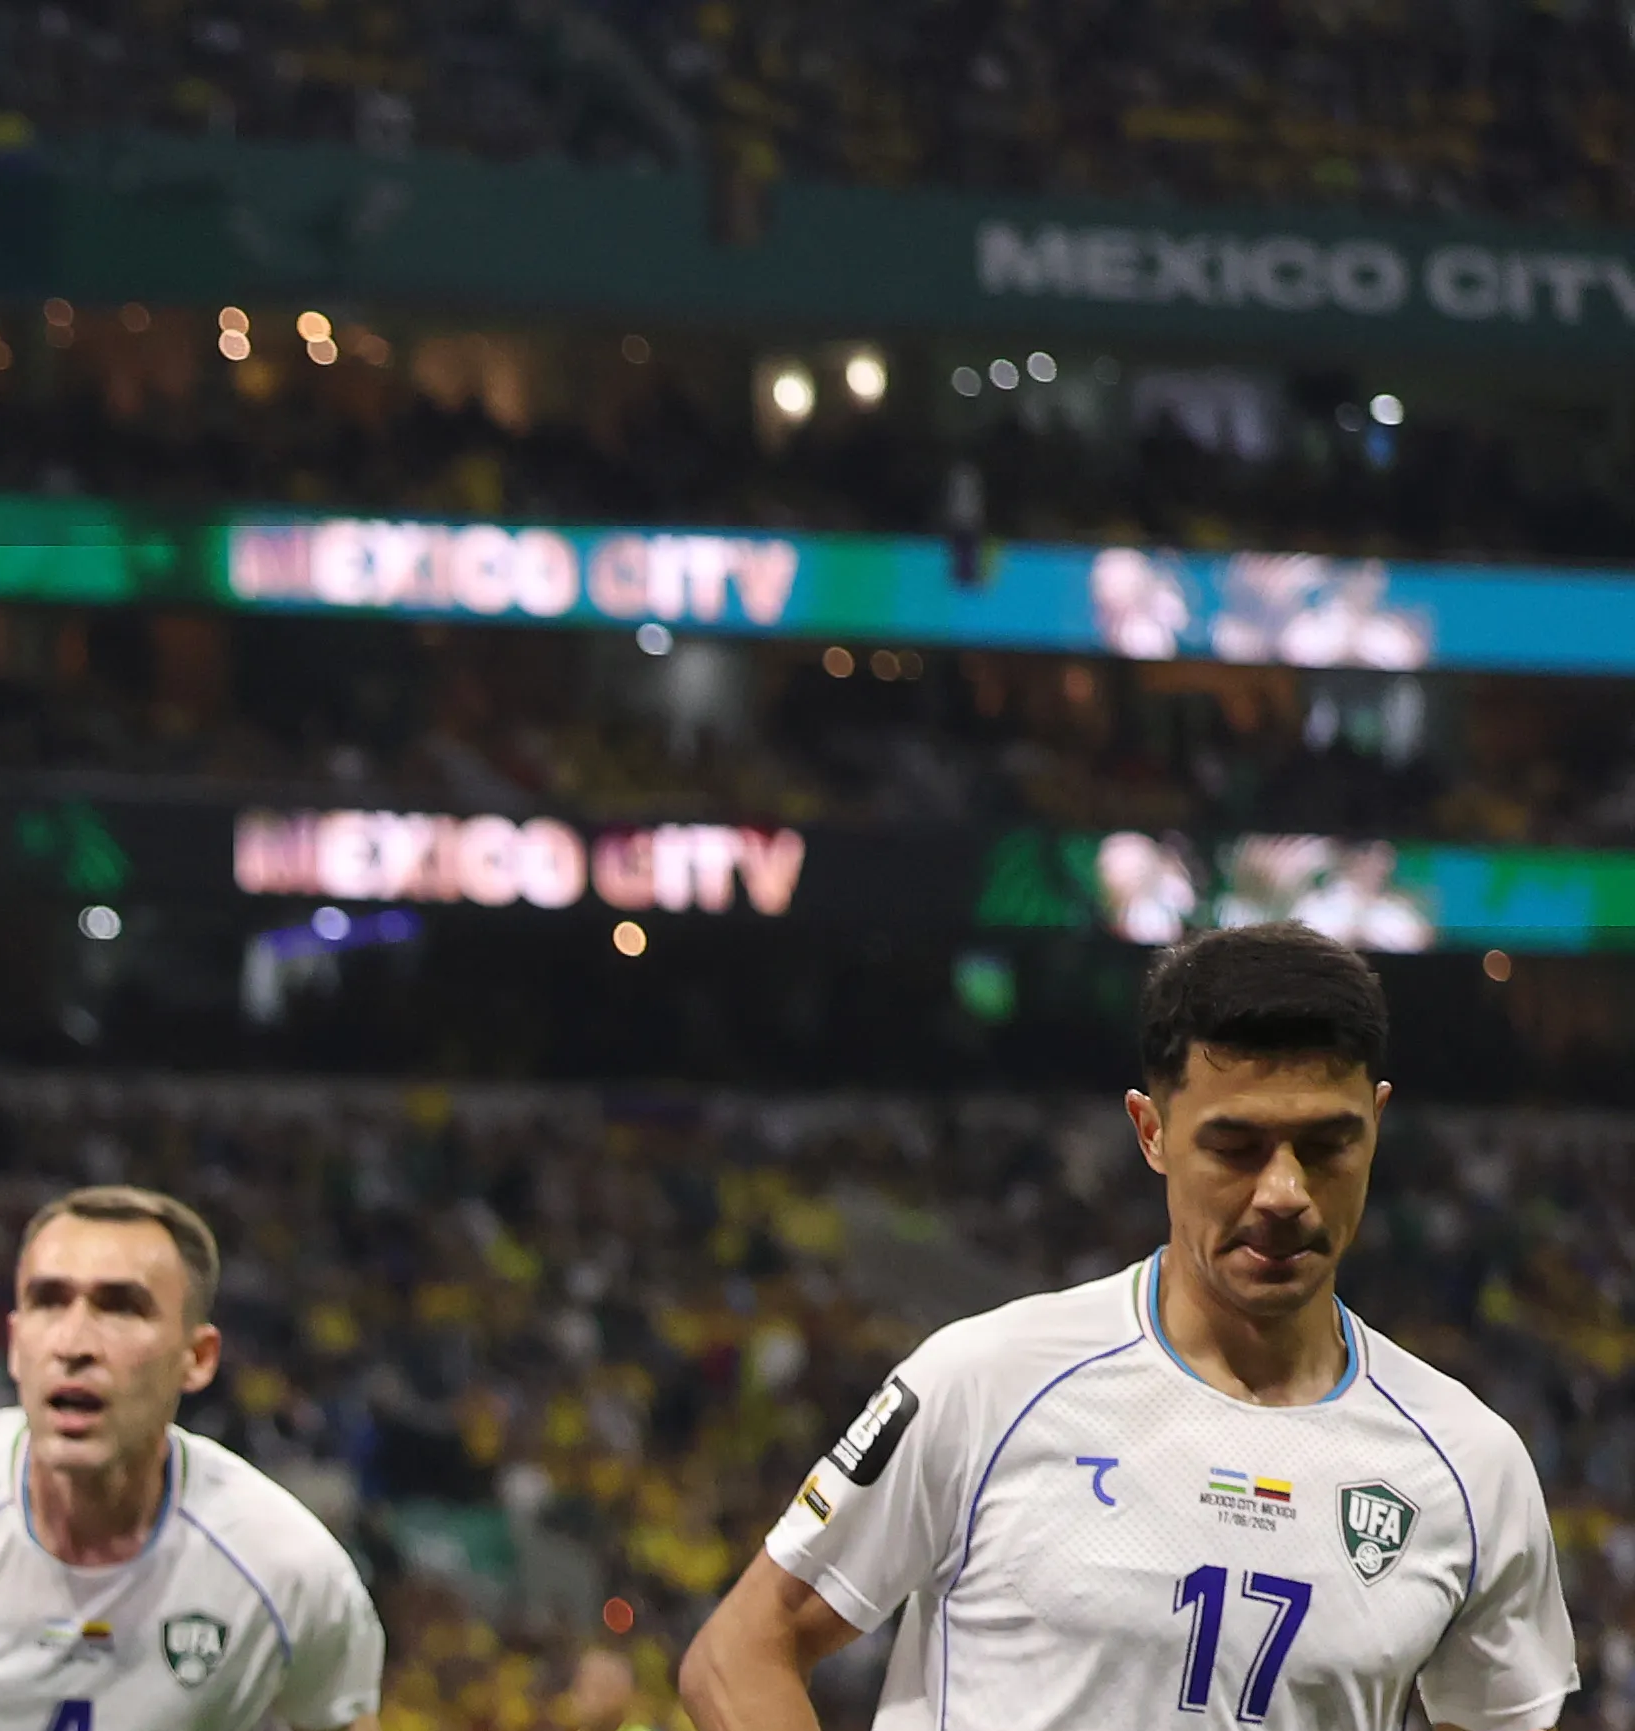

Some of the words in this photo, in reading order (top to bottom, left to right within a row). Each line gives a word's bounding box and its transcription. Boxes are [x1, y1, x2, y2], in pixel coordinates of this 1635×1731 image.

[976, 222, 1409, 312] MEXICO
[231, 520, 579, 618] MEXICO
[1348, 1496, 1402, 1545] UFA
[1172, 1564, 1313, 1726] 17
